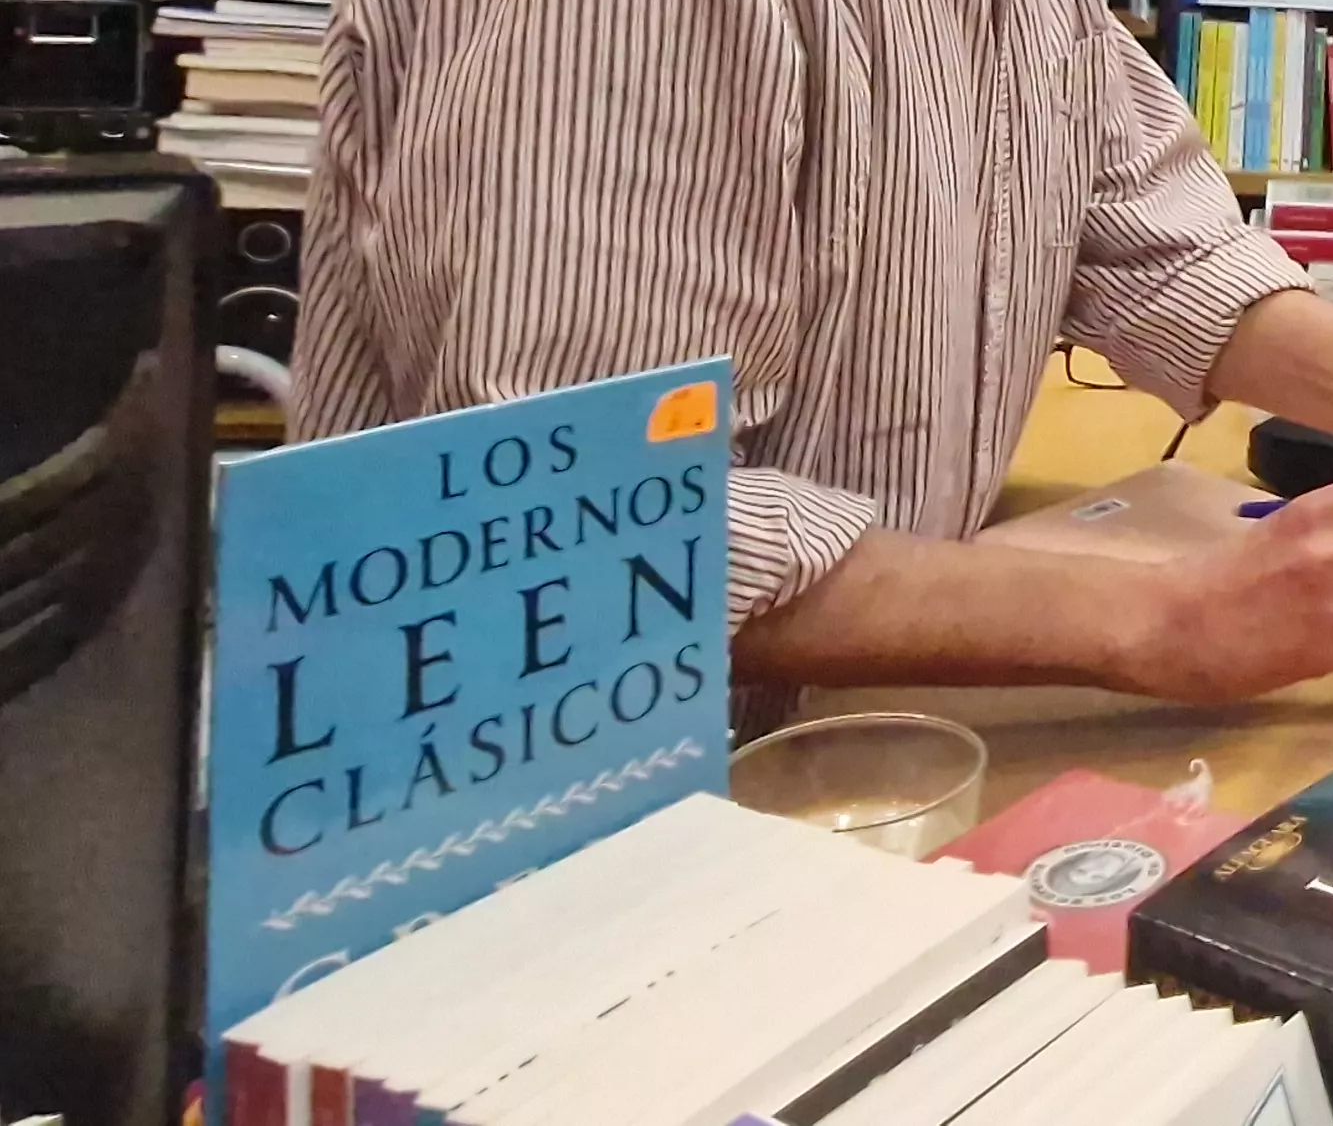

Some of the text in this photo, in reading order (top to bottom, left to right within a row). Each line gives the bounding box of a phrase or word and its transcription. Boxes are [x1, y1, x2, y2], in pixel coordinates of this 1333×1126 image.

[266, 464, 706, 632] MODERNOS
[438, 424, 577, 501] LOS
[266, 536, 702, 765] LEEN
[260, 642, 705, 855] CLÁSICOS
